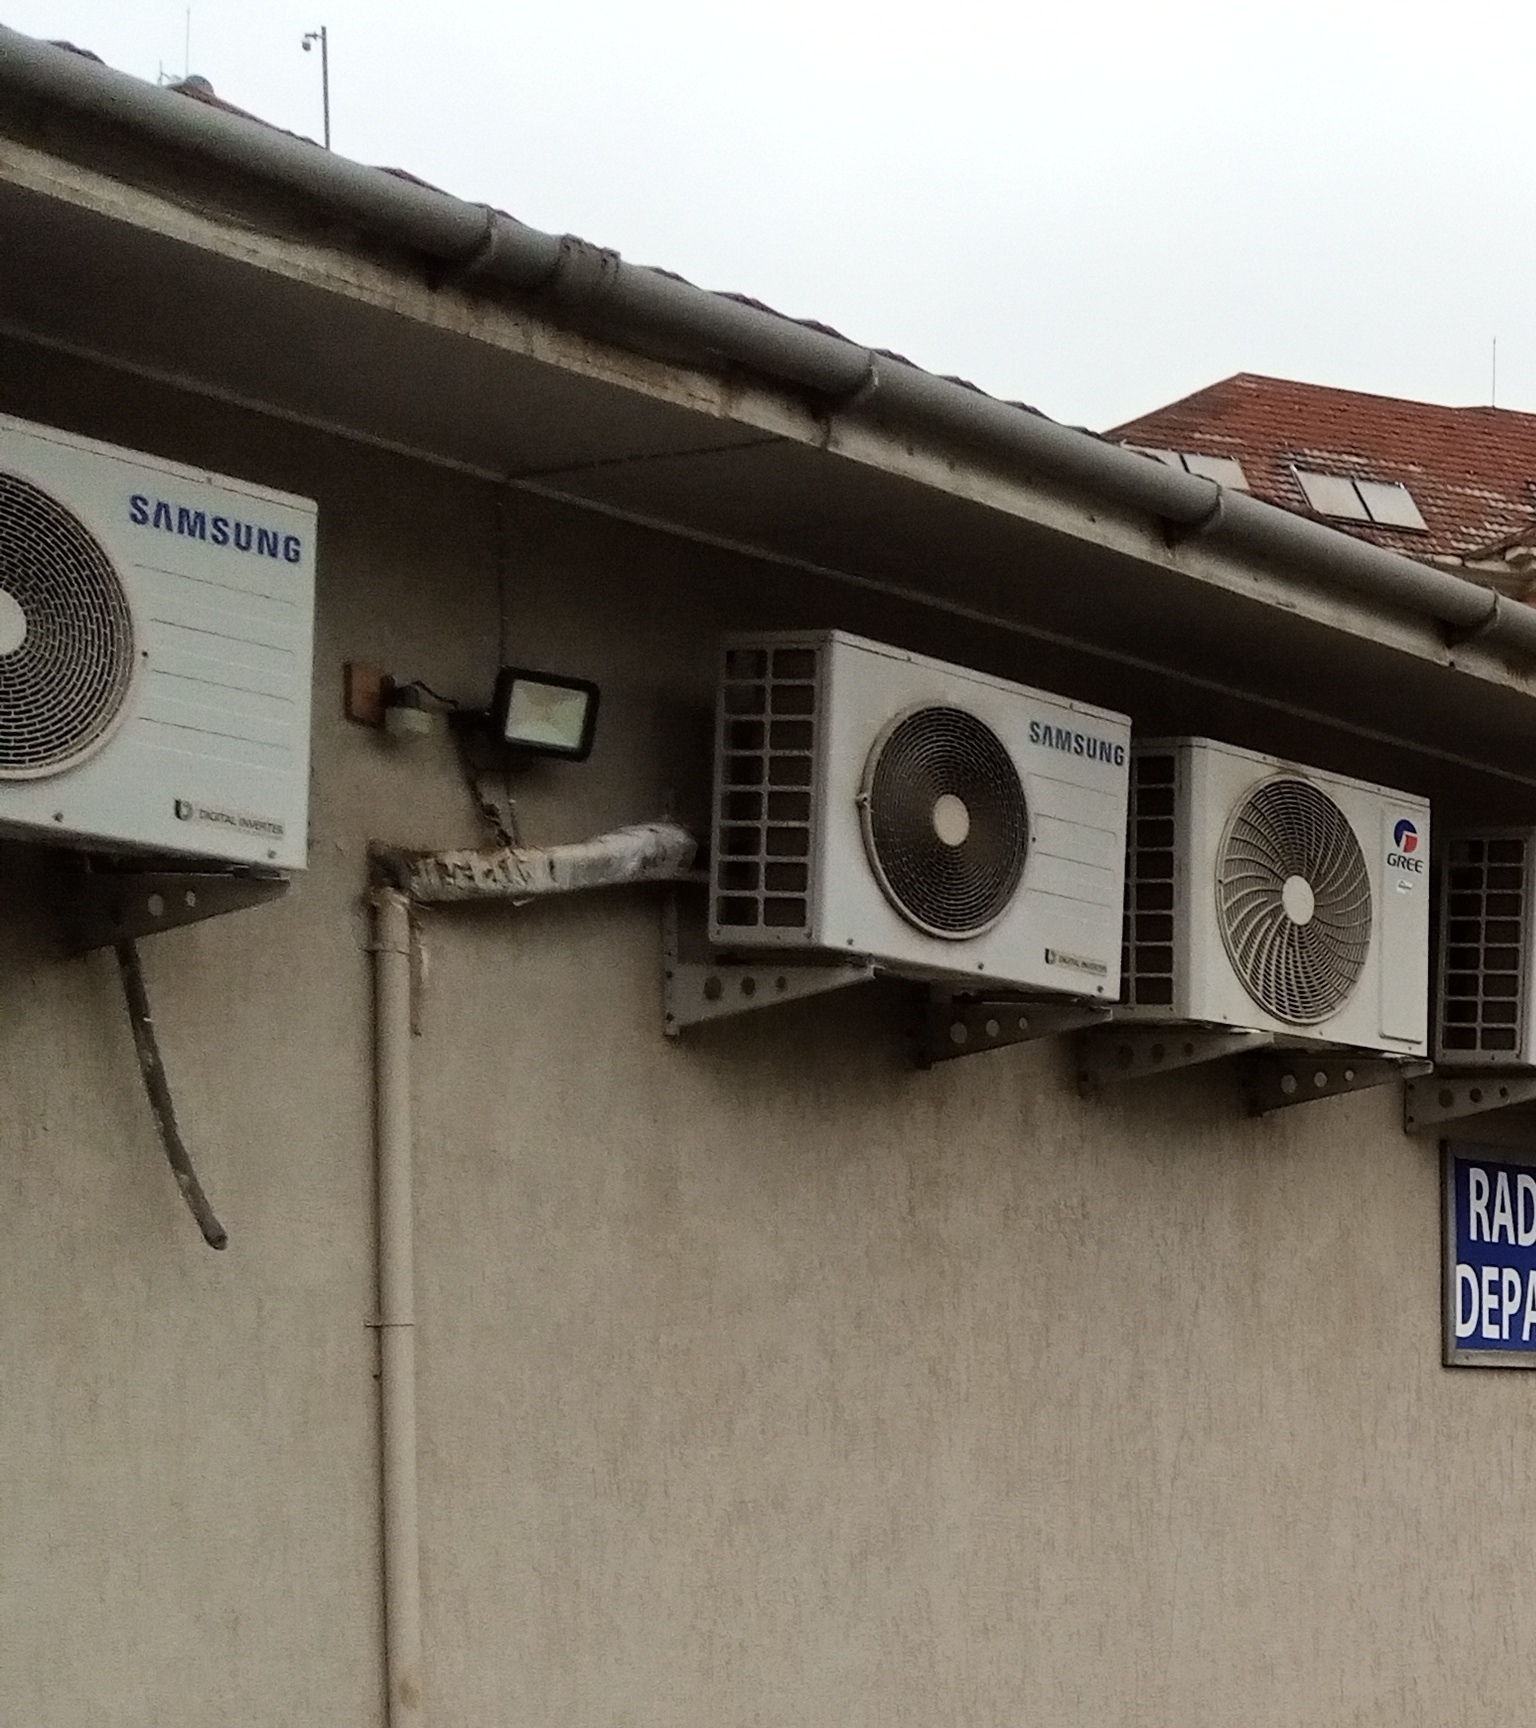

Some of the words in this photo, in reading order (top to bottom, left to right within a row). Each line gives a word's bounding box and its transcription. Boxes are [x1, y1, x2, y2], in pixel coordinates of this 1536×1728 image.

[129, 494, 301, 563] SAMSUNG
[1029, 720, 1125, 767] SAMSUNG
[1386, 852, 1424, 874] GREE
